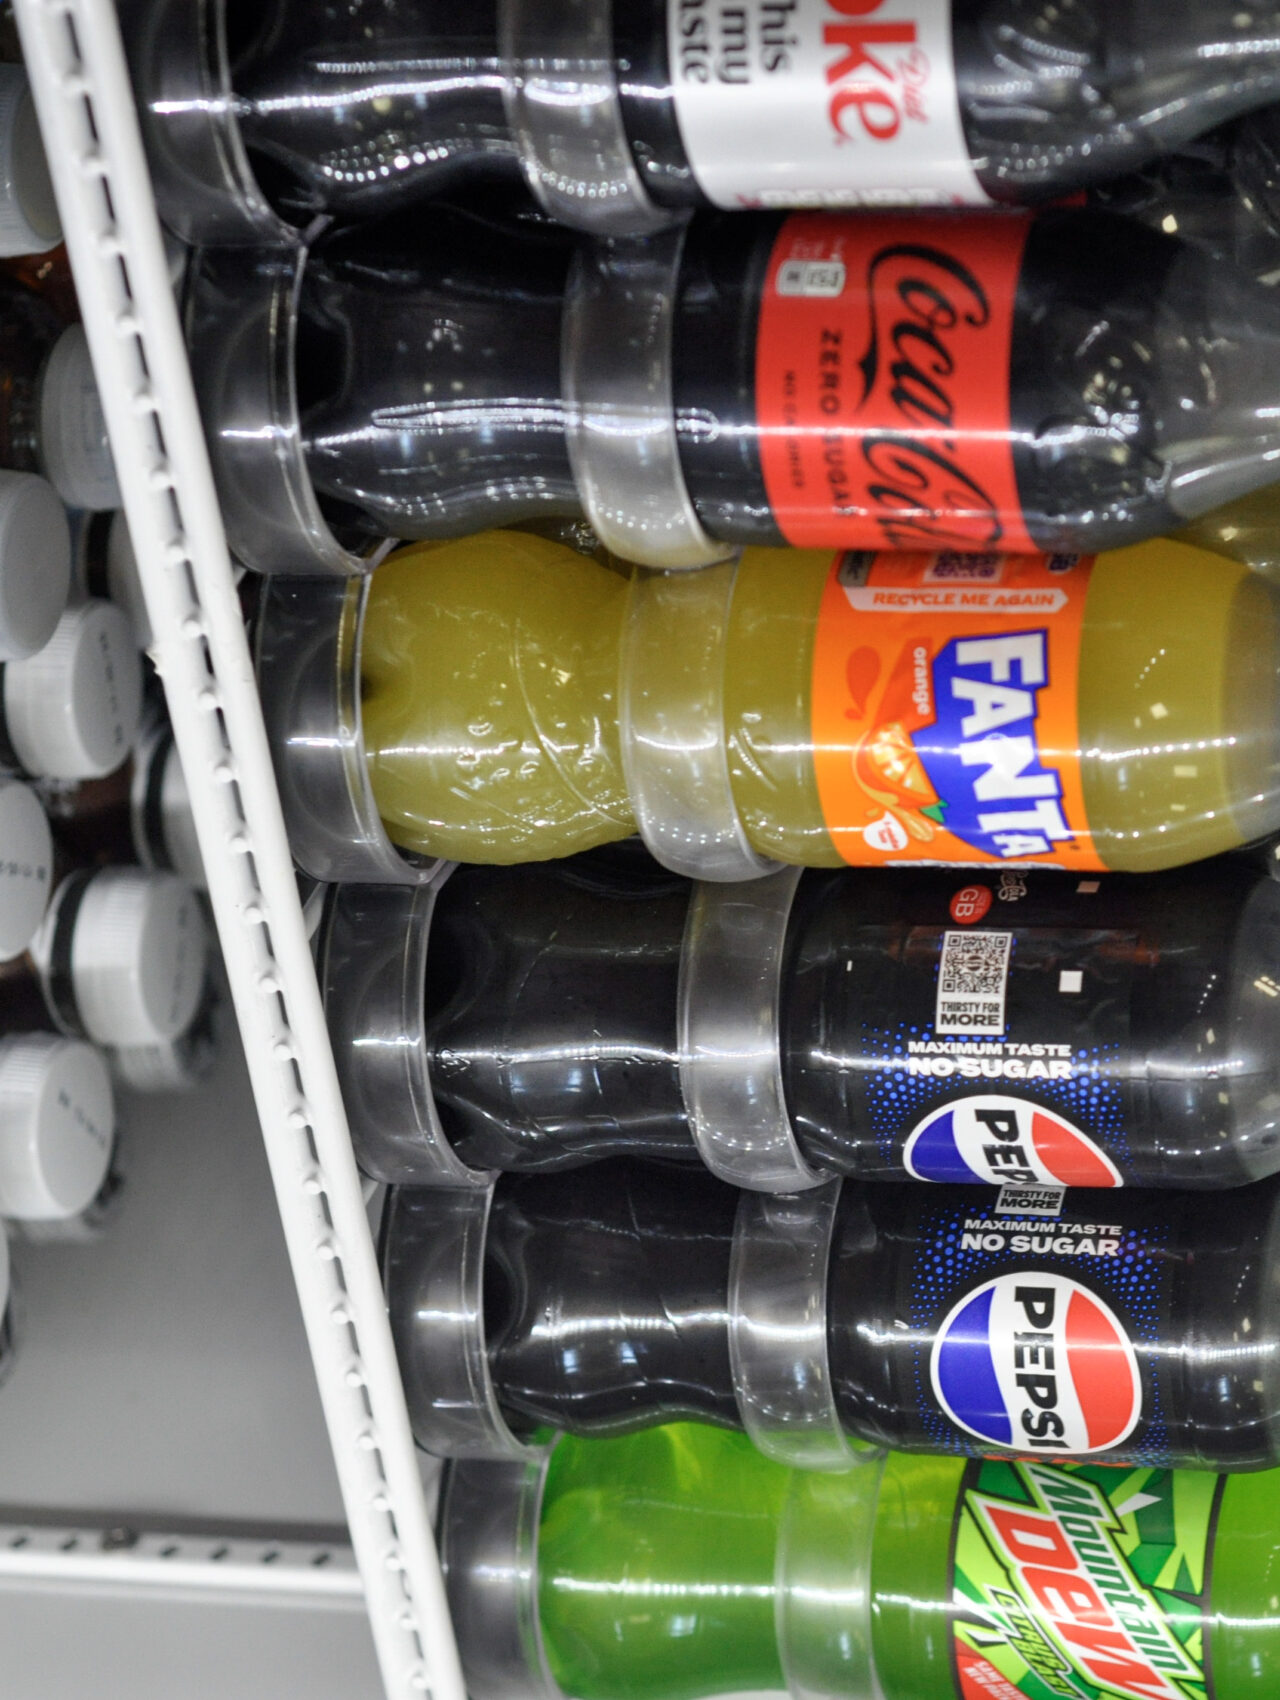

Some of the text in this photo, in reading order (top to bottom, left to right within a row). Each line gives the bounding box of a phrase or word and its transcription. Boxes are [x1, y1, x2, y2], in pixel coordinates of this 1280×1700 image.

[720, 9, 751, 85] my
[819, 329, 842, 415] ZERO
[873, 593, 1055, 607] RECYCLE ME AGAIN
[912, 647, 931, 716] orange
[951, 632, 1071, 858] FANTA
[955, 887, 978, 918] GB
[939, 1013, 1001, 1026] MORE
[940, 1001, 1000, 1013] THIRSTY FOR
[907, 1041, 1072, 1058] MAXIMUM TASTE
[908, 1057, 1073, 1080] NO SUGAR
[999, 1198, 1060, 1211] MORE
[1003, 1188, 1062, 1201] THIRSTY FOR
[963, 1218, 1123, 1236] MAXIMUM TASTE
[960, 1233, 1121, 1257] NO SUGAR
[1013, 1285, 1074, 1450] PEPSI
[1028, 1463, 1189, 1672] Mountain
[983, 1505, 1188, 1700] Dew
[994, 1591, 1068, 1672] CITRUS
